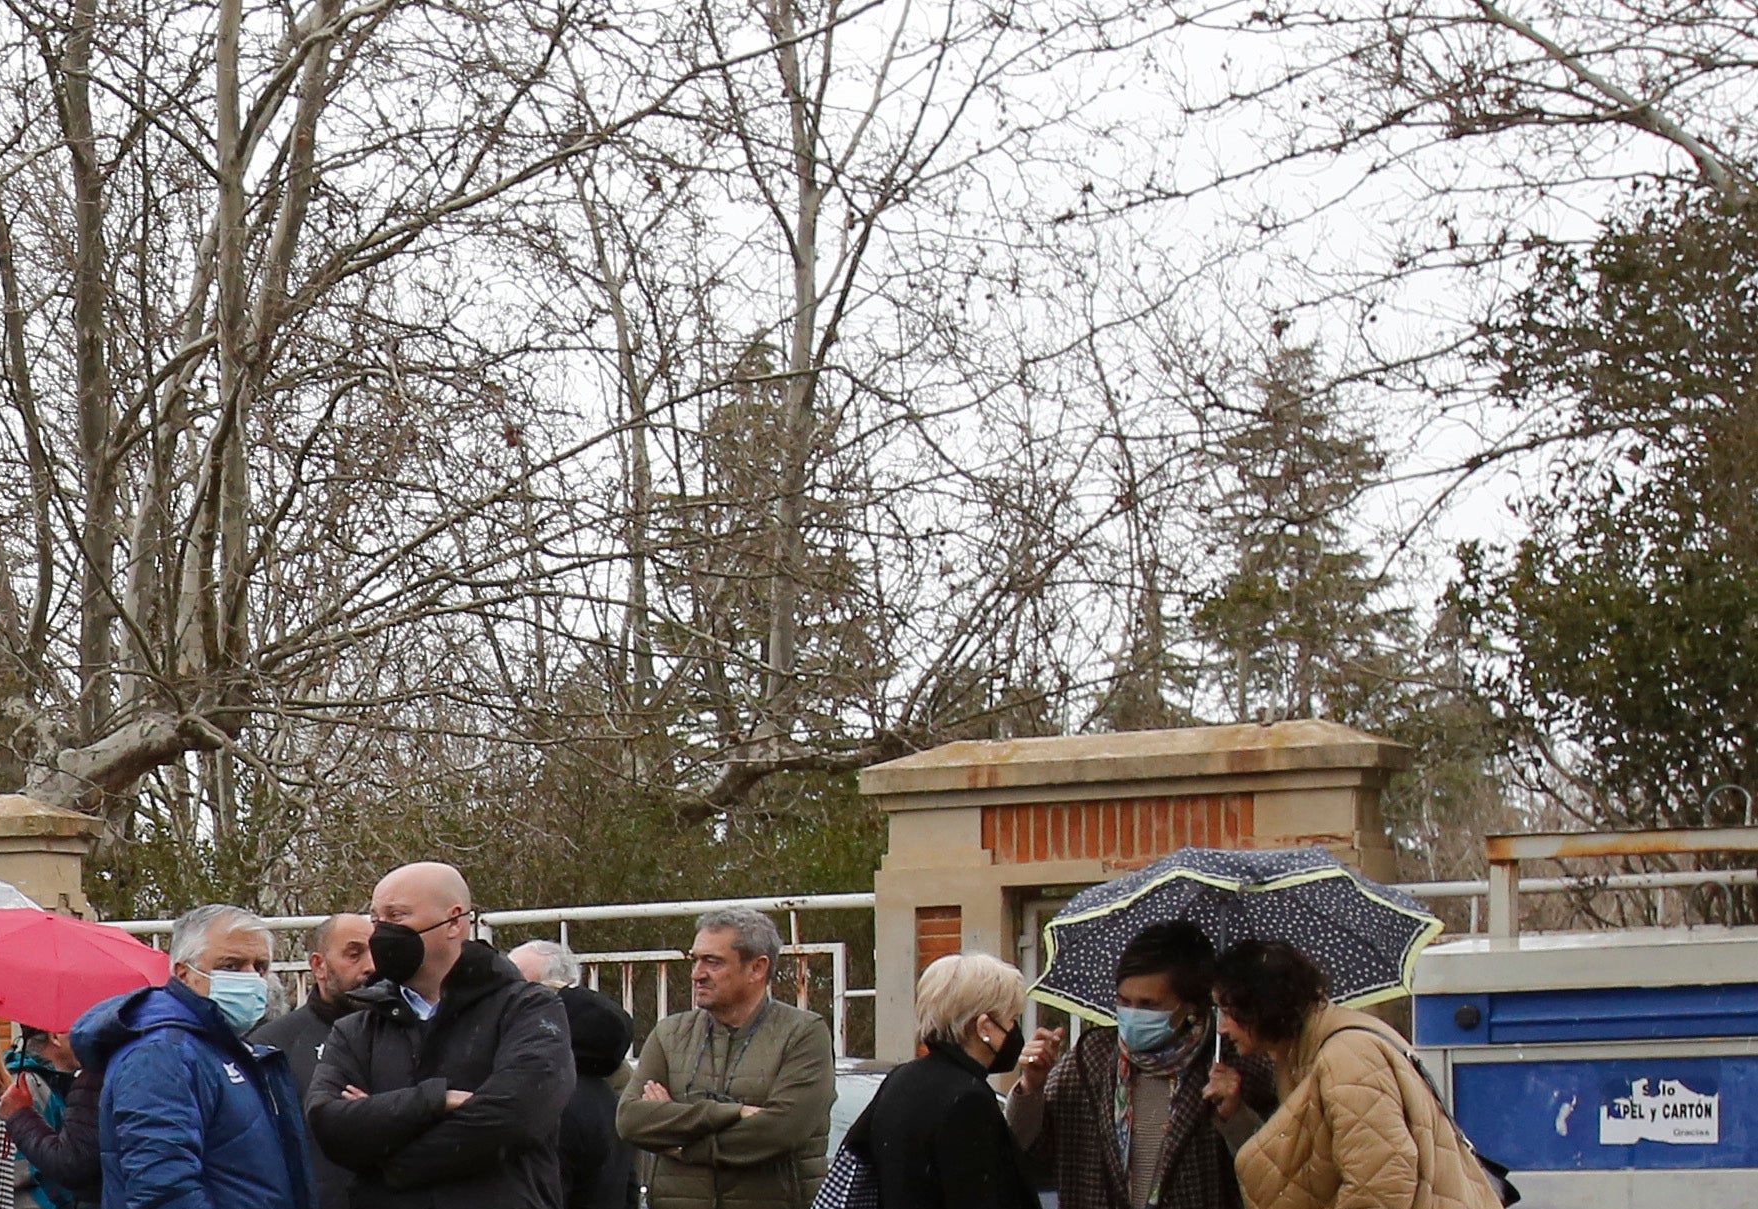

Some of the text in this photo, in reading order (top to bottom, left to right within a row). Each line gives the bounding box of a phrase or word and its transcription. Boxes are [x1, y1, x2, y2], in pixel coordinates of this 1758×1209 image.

[1641, 1084, 1676, 1097] Slo
[1606, 1099, 1713, 1123] PEL y CARTÓN
